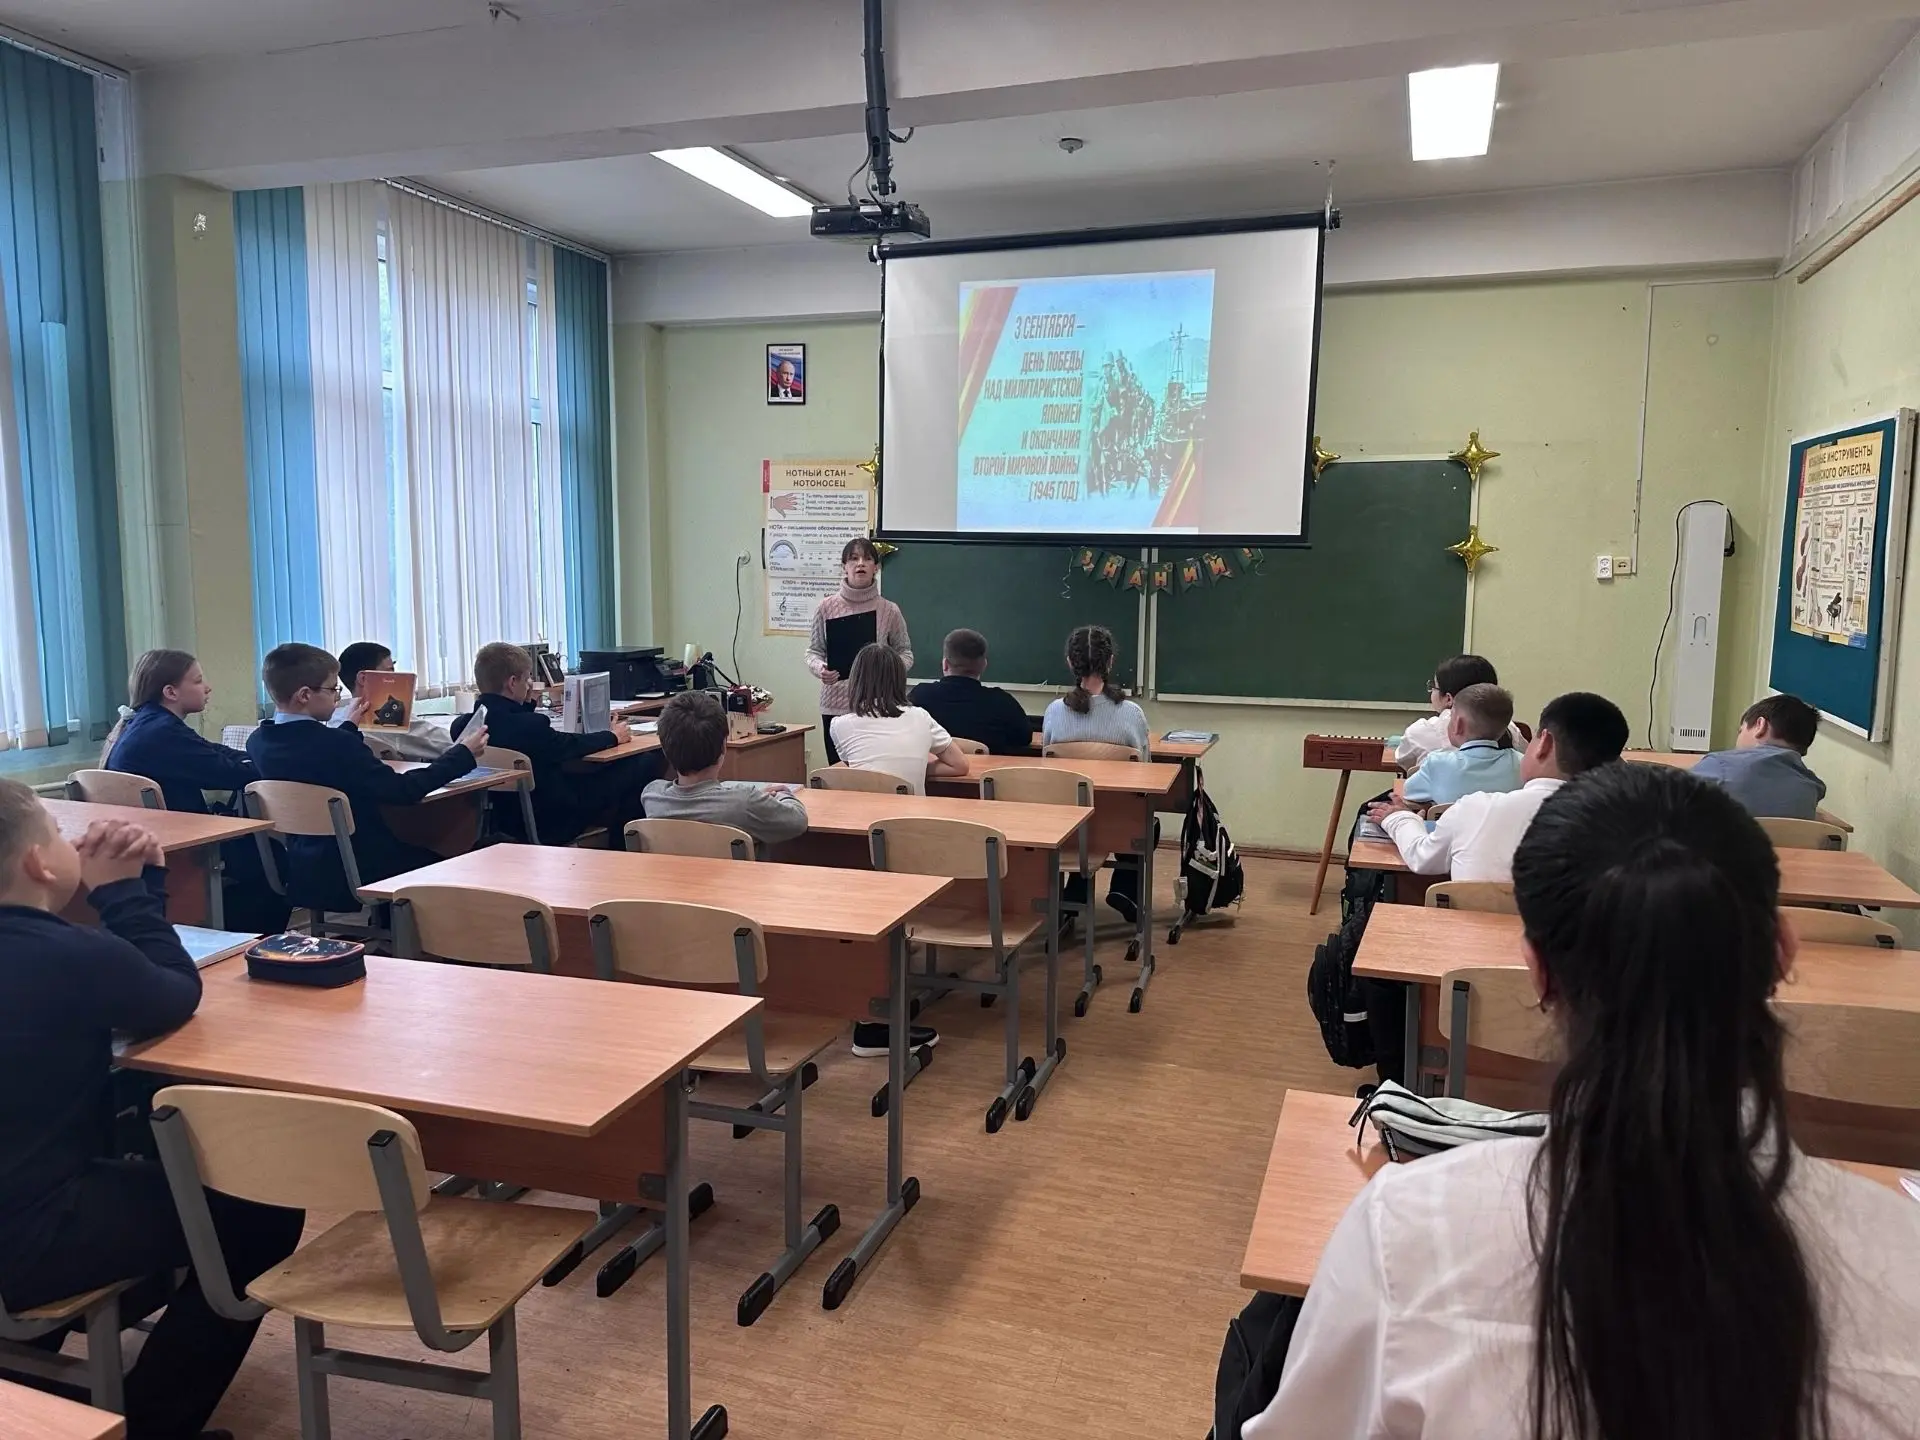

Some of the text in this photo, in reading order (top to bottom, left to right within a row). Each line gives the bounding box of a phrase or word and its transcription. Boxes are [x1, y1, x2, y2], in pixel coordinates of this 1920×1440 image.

[1014, 315, 1022, 340] 3
[1022, 313, 1076, 340] СЕНТЯБРЯ
[1021, 349, 1085, 375] ДЕНЬ ПОБЕДЫ
[983, 372, 1084, 400] НАД МИЛИТАРИСТСКОЙ
[1041, 398, 1083, 425] ЯПОНИЕЙ
[1020, 429, 1082, 450] И ОКОНЧАНИЯ
[785, 467, 822, 477] НОТНЫЙ
[824, 469, 847, 477] СТАН
[973, 451, 1081, 476] ВТОРОЙ МИРОВОЙ ВОЙНЫ
[1838, 462, 1871, 477] ОРКЕСТРА
[793, 479, 846, 488] НОТОНОСЕЦ
